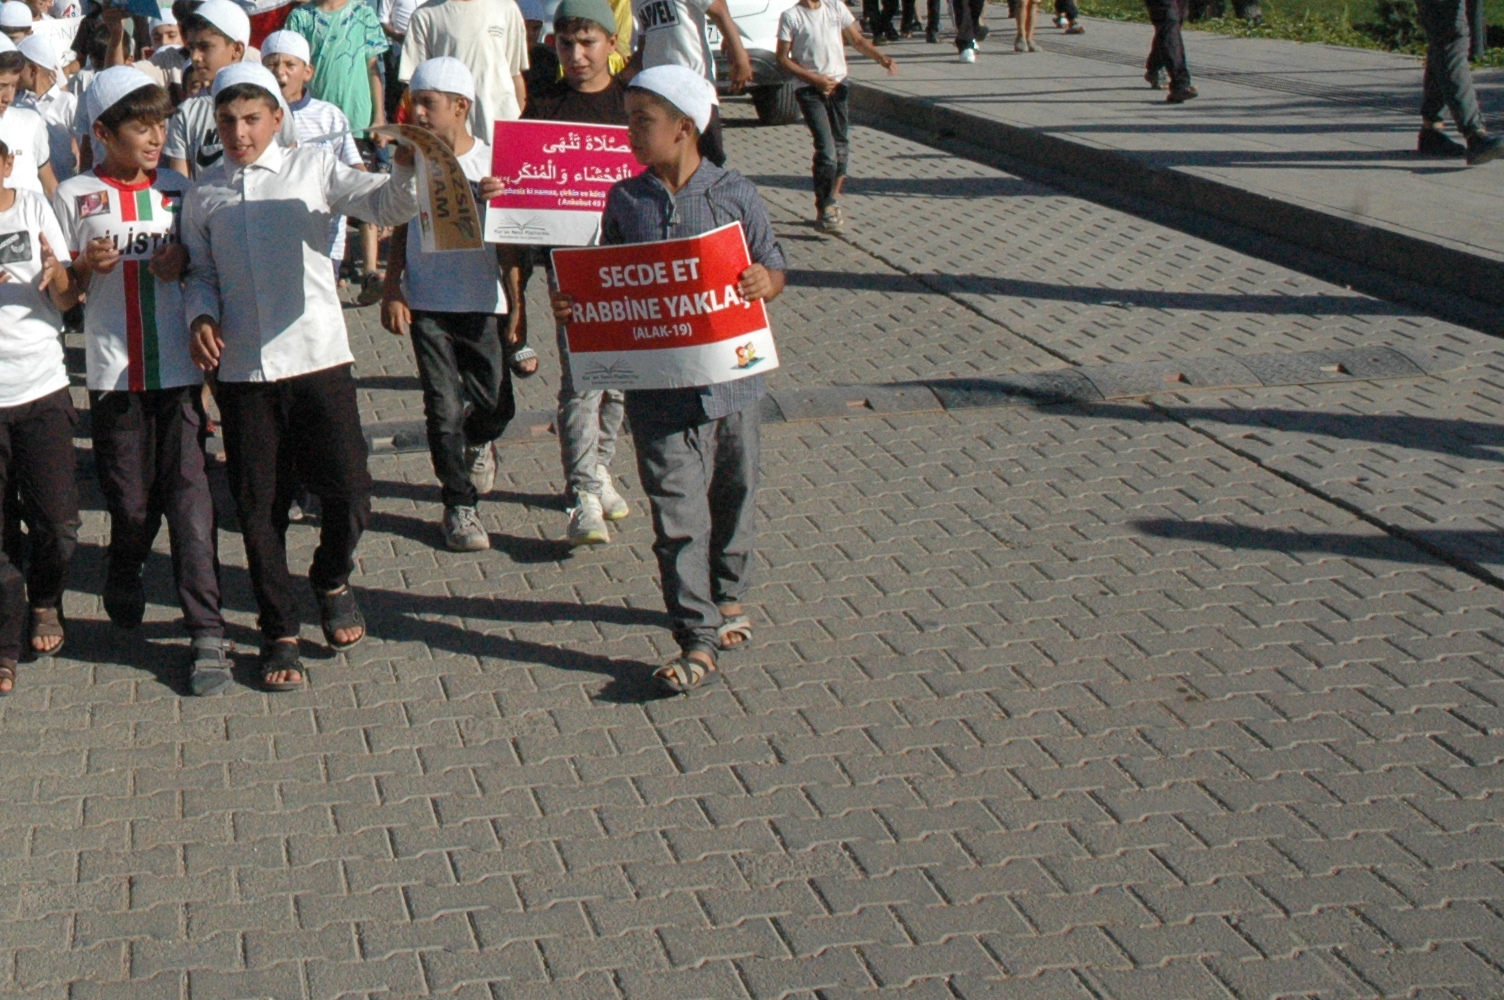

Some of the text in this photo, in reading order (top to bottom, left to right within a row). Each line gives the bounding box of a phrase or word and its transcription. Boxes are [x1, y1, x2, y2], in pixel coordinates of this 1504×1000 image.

[599, 257, 700, 288] SECDE ET
[572, 295, 663, 323] RABBİNE
[632, 323, 693, 340] (ALAK-19)
